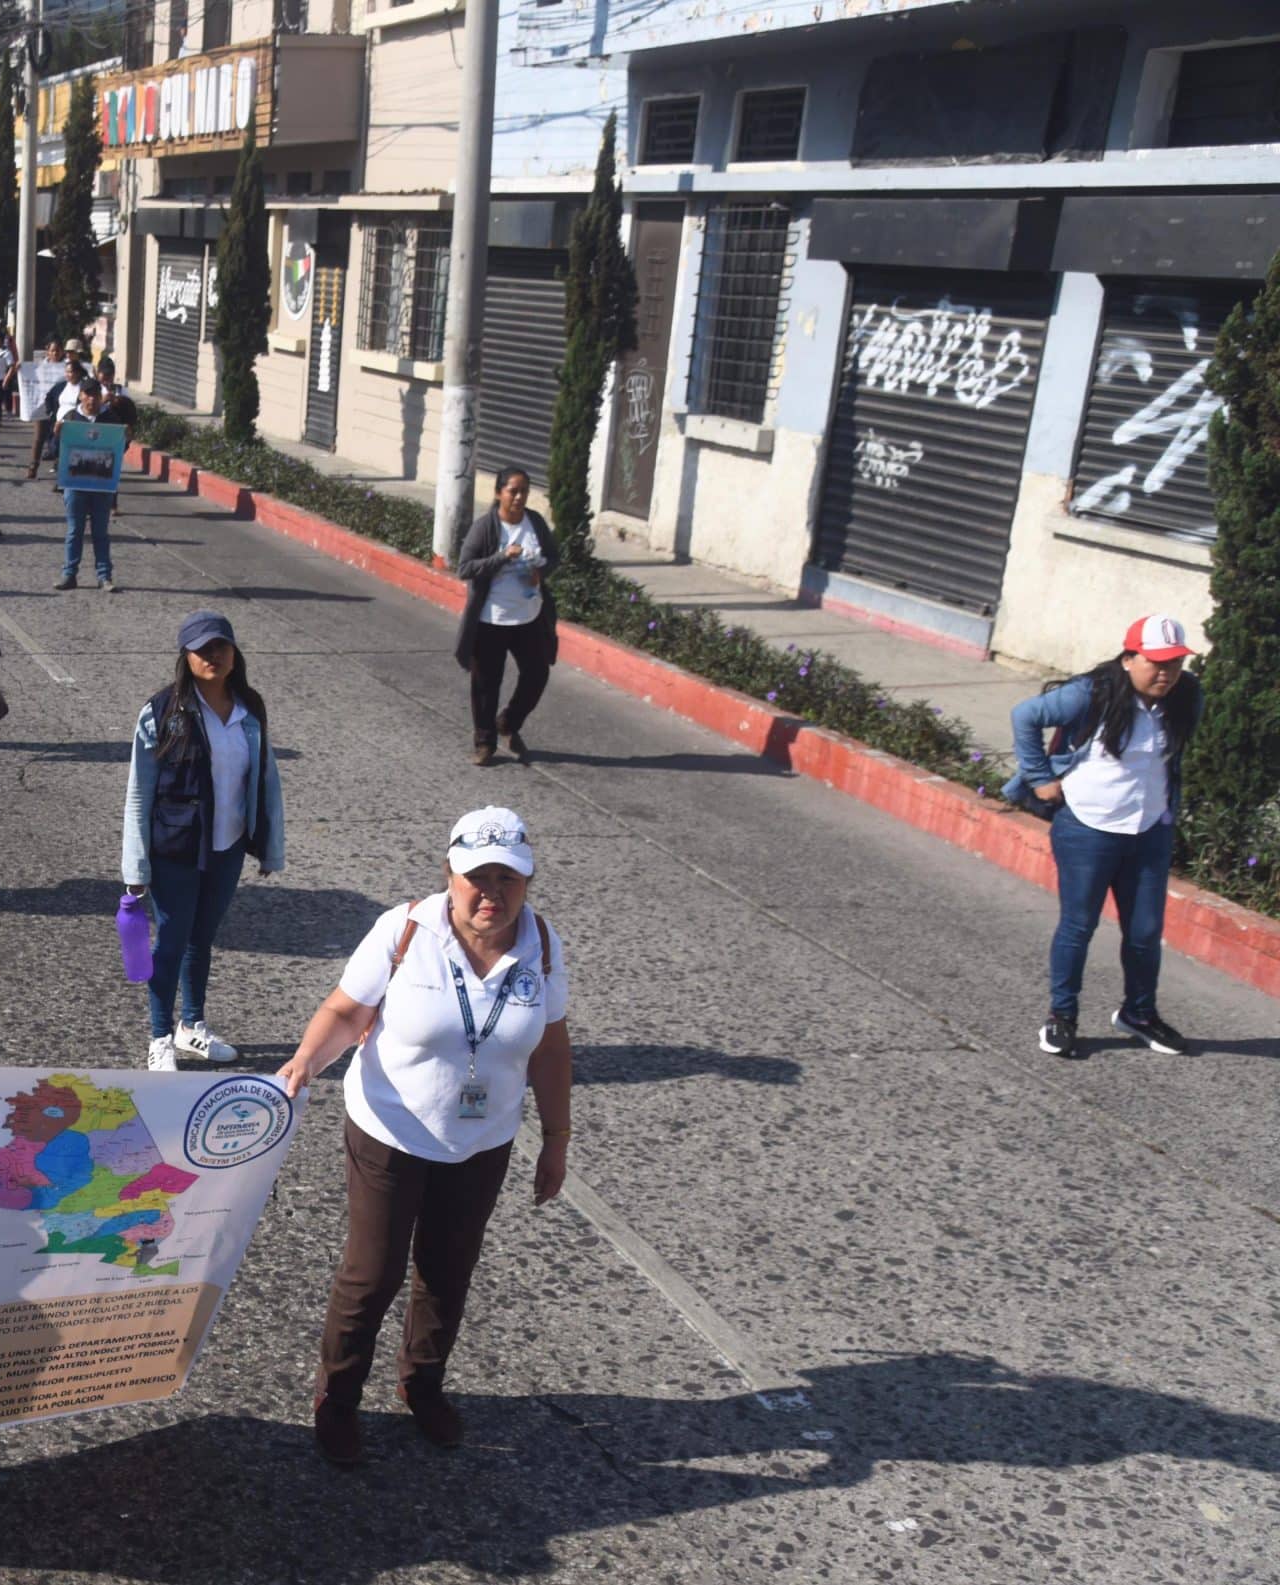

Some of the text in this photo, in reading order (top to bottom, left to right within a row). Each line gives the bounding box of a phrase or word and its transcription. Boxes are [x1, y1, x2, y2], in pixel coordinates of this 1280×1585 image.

[203, 1085, 249, 1111] NACIONAL
[250, 1086, 261, 1095] DE
[105, 1289, 170, 1303] COMBUSTIBLE
[181, 1286, 199, 1294] LOS
[13, 1314, 29, 1323] LES
[32, 1310, 70, 1321] BRINDO
[73, 1303, 120, 1317] VEHICULO
[28, 1317, 89, 1330] ACTIVIDADES
[91, 1313, 130, 1323] DENTRO
[8, 1350, 31, 1359] UNO
[68, 1333, 152, 1348] DEPARTAMENTOS
[40, 1354, 60, 1363] CON
[63, 1350, 88, 1359] ALTO
[90, 1346, 121, 1356] INDICE
[138, 1339, 179, 1349] POBREZA
[6, 1367, 46, 1378] MUERTE
[49, 1360, 96, 1371] MATERNA
[106, 1348, 175, 1363] DESNUTRICION
[31, 1377, 64, 1388] MEJOR
[66, 1366, 133, 1383] PRESUPUESTO
[31, 1391, 57, 1401] HORA
[75, 1383, 112, 1394] ACTUAR
[129, 1374, 177, 1386] BENEFICIO
[51, 1394, 105, 1408] POBLACION
